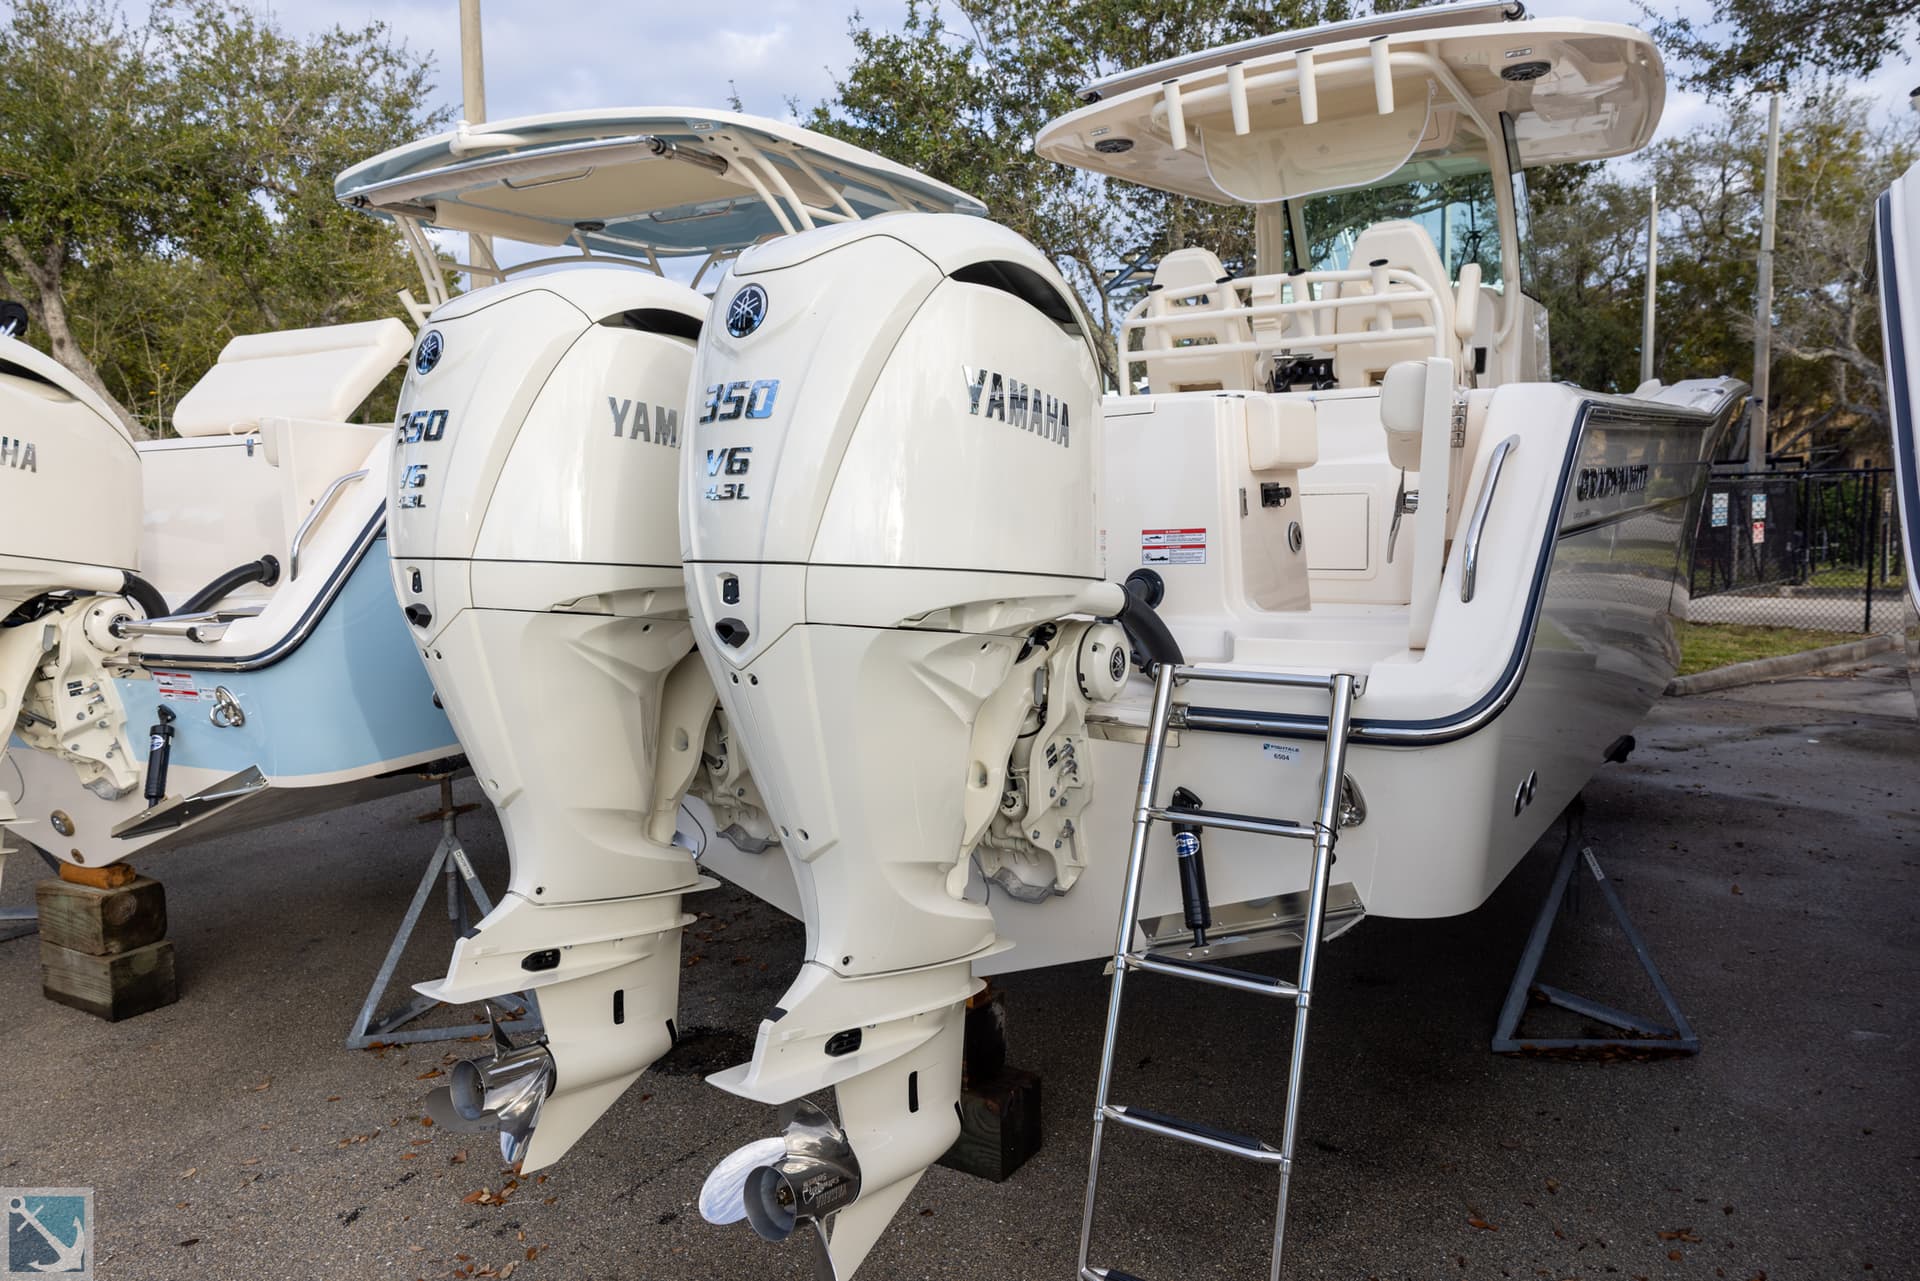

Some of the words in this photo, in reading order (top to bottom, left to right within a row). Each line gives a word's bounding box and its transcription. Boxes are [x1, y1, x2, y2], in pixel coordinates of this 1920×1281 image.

[608, 396, 682, 450] YAM
[699, 379, 780, 424] 350
[961, 363, 1070, 449] YAMAHA
[706, 446, 753, 477] V6
